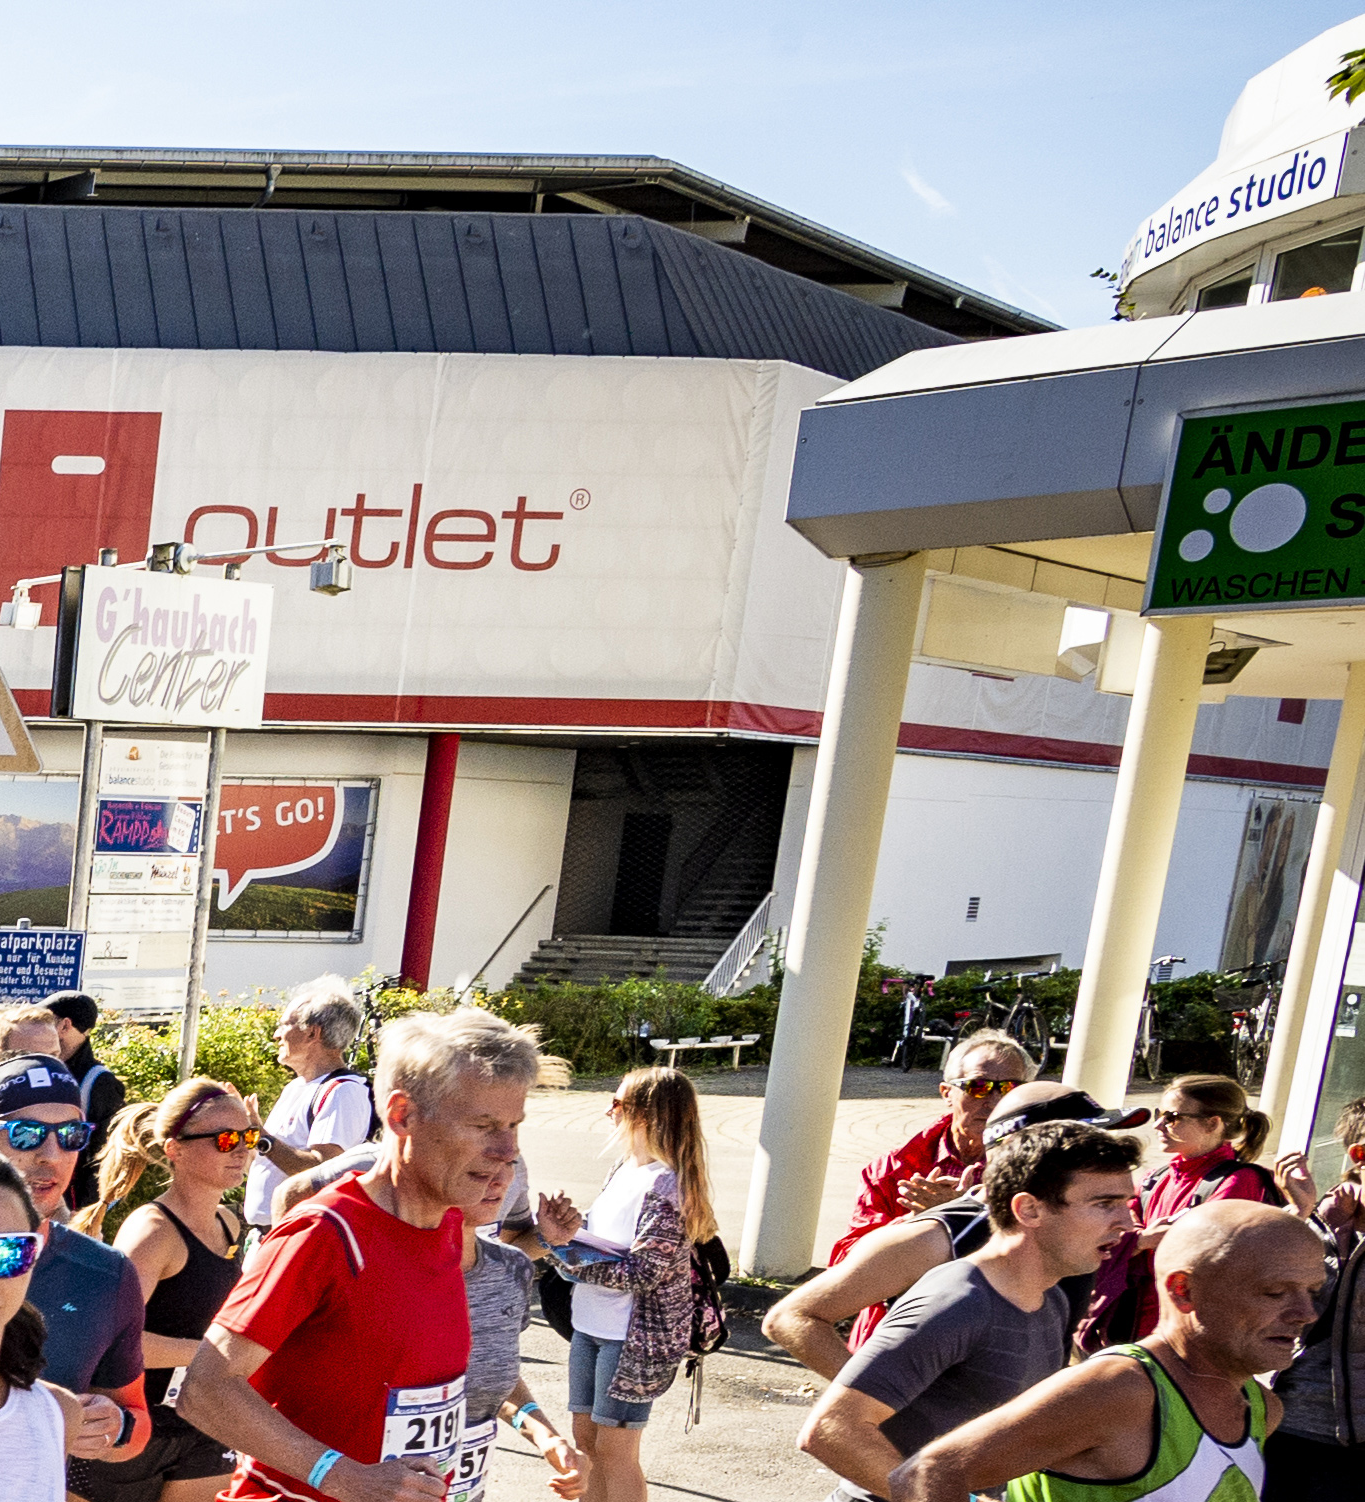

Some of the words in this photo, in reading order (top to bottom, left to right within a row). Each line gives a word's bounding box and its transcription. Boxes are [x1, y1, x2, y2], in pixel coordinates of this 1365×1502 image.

[1144, 196, 1219, 258] balance
[1227, 150, 1326, 218] studio
[184, 483, 564, 572] outlet
[1171, 567, 1351, 602] WASCHEN
[98, 623, 251, 713] Center
[216, 806, 261, 835] T'S
[275, 796, 325, 827] GO!
[7, 953, 22, 963] nur
[27, 952, 41, 963] für
[45, 953, 76, 964] Kunden
[16, 965, 32, 975] und
[33, 965, 74, 976] Besucher
